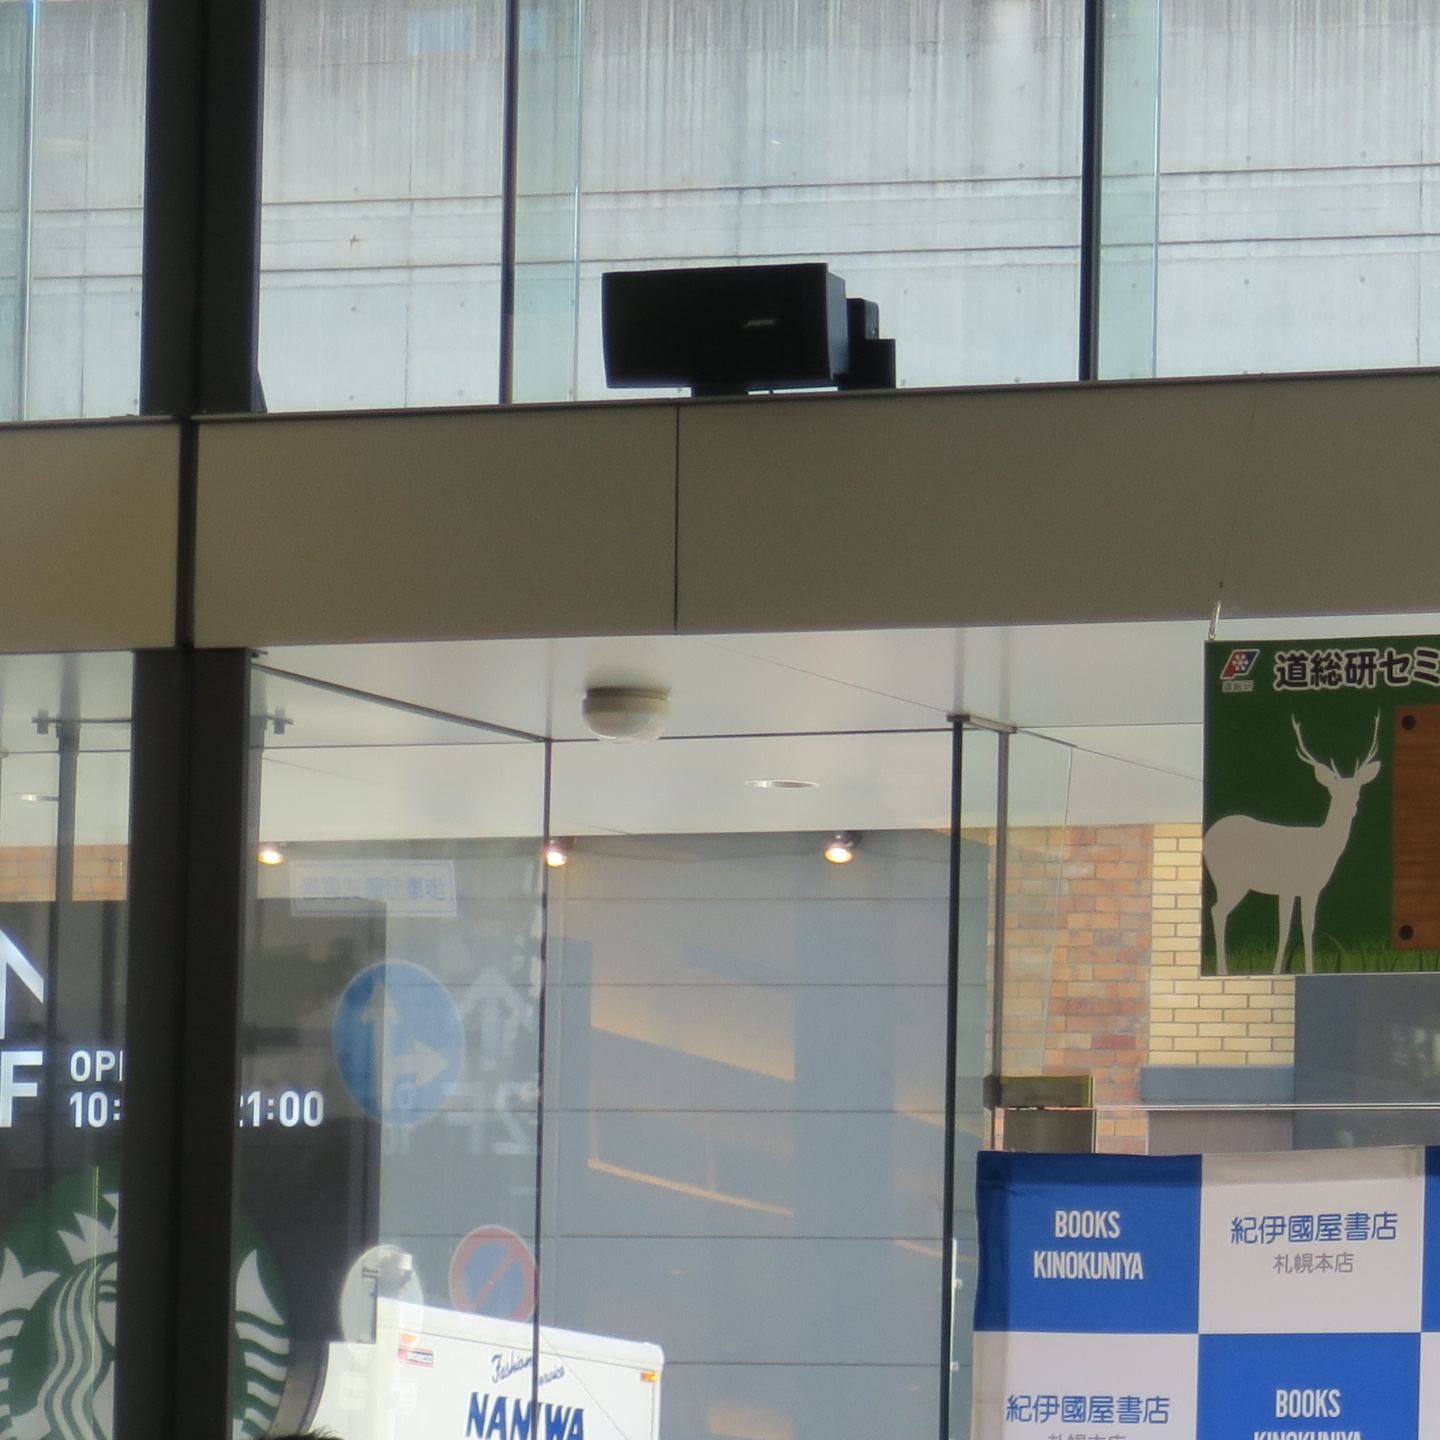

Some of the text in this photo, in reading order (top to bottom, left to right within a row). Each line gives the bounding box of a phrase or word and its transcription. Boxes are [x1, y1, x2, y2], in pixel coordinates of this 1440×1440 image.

[69, 1050, 124, 1083] OP
[1055, 1211, 1120, 1238] BOOKS
[1231, 1211, 1397, 1244] 紀伊國屋書店
[1034, 1251, 1143, 1279] KINOKUNIYA
[1274, 1252, 1353, 1273] 札幌本店
[1006, 1392, 1169, 1424] 紀伊國屋書店
[1276, 1389, 1340, 1417] BOOKS
